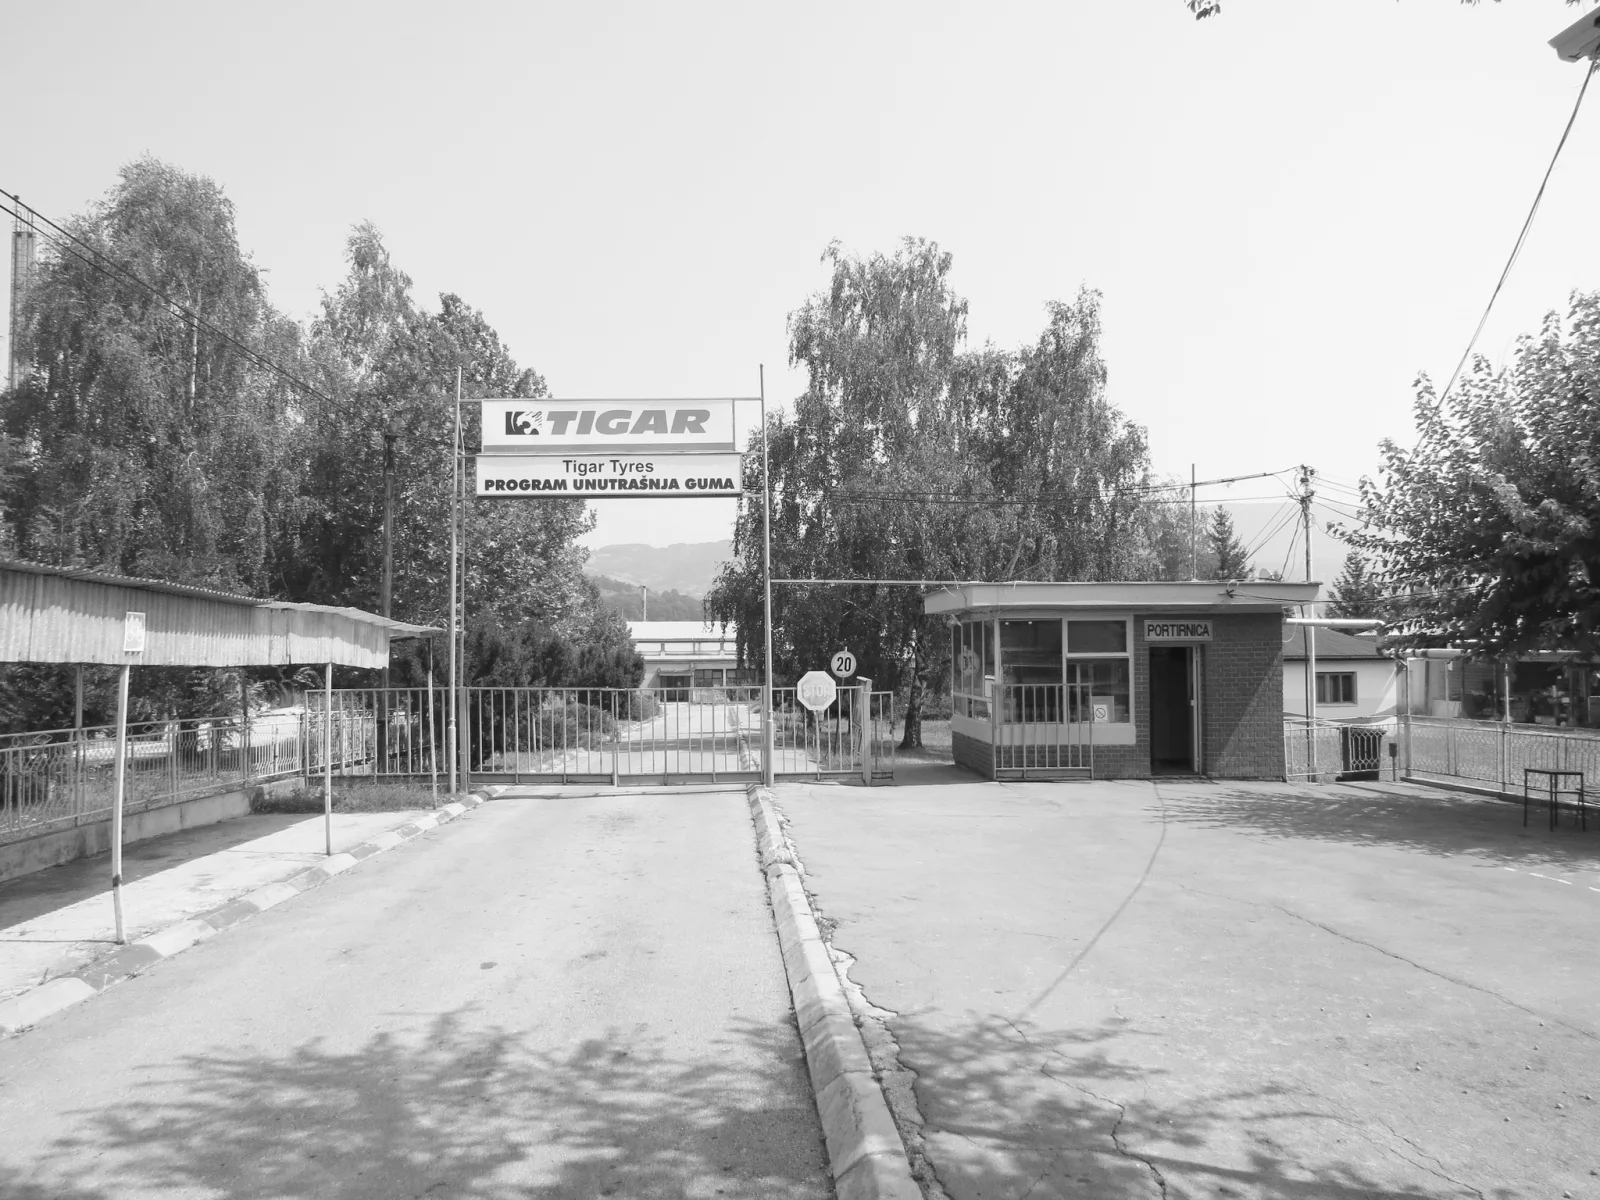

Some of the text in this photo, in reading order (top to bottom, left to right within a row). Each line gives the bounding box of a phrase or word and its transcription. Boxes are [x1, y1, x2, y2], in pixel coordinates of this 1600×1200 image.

[546, 409, 710, 435] TIGAR
[562, 460, 654, 476] Tigar Tyres
[484, 475, 735, 491] PROGRAM UNUTRAŠNJA GUMA
[1147, 623, 1210, 637] PORTIRNICA
[836, 656, 852, 672] 20
